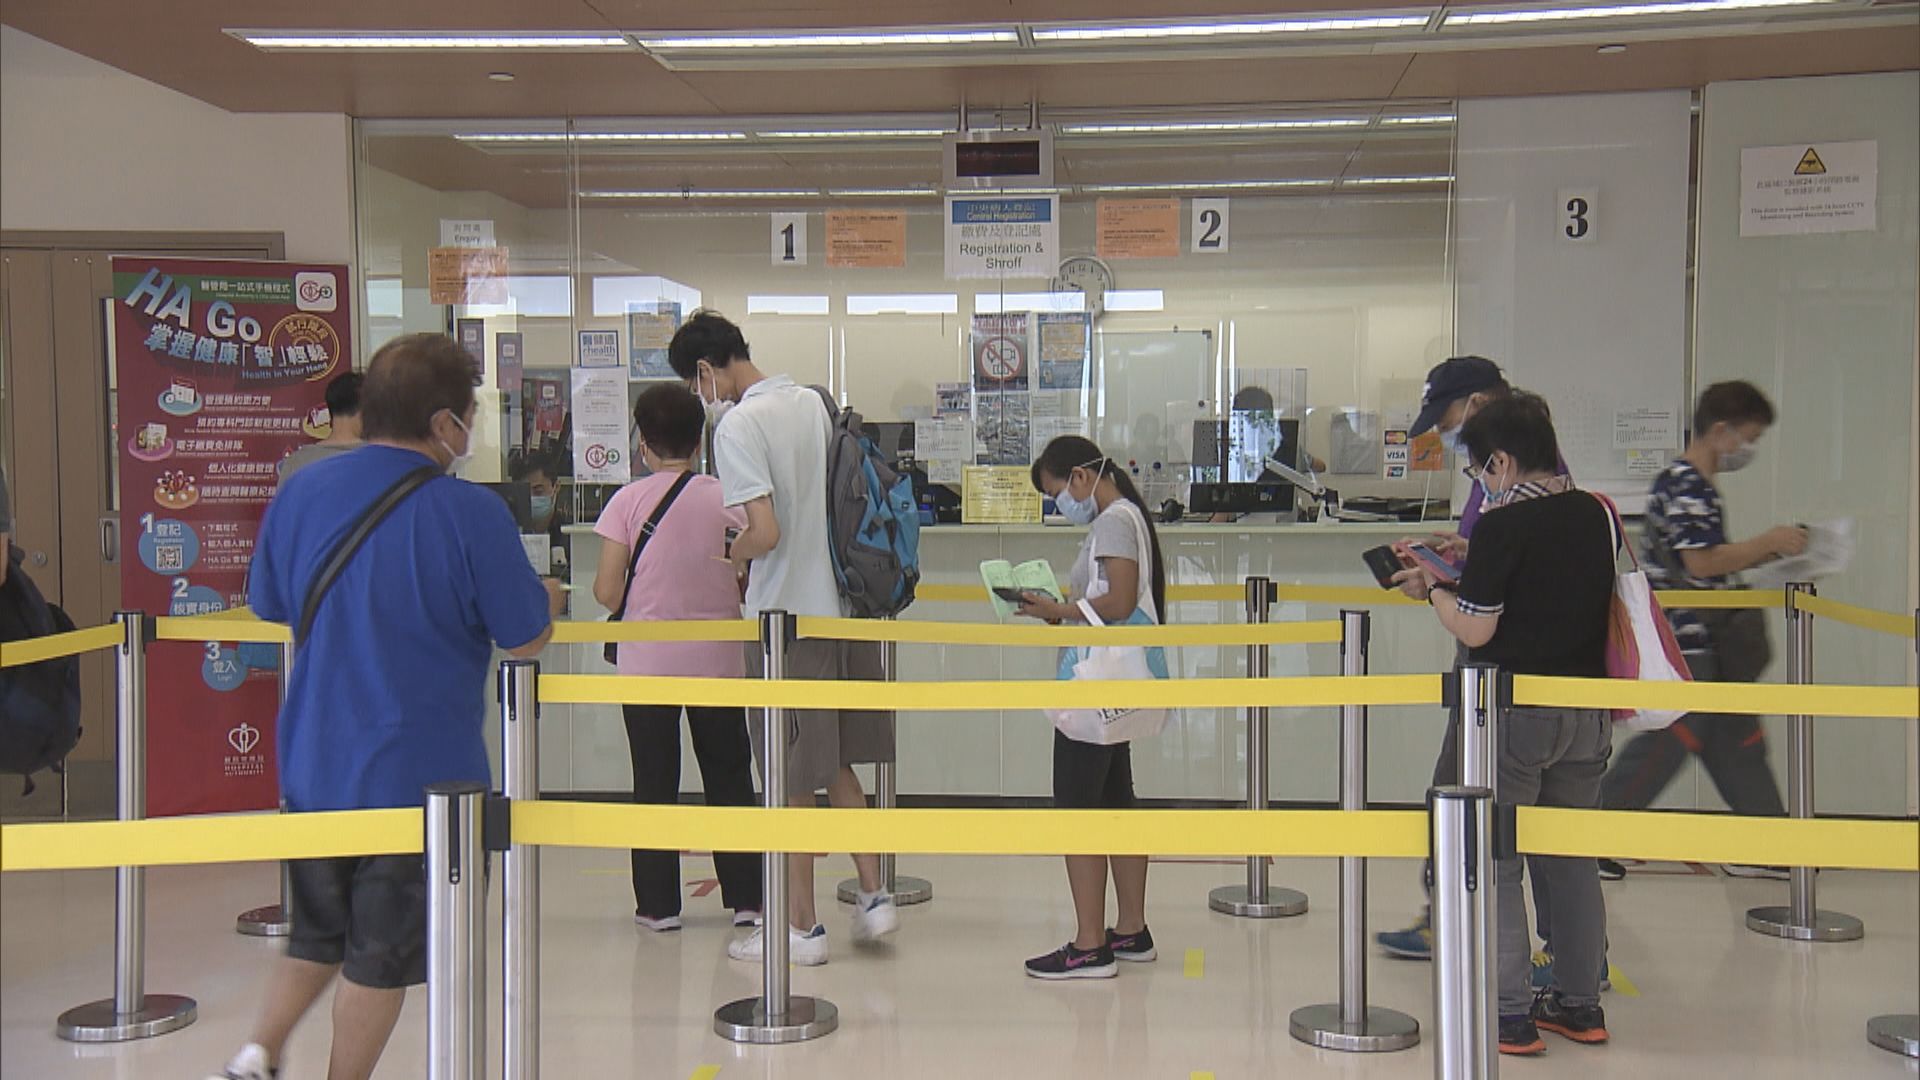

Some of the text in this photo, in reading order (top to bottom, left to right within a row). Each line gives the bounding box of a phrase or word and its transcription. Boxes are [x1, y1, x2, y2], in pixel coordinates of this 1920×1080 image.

[967, 212, 1036, 221] Central Registration
[1566, 199, 1588, 238] 3
[1199, 209, 1223, 247] 2
[780, 222, 795, 261] 1
[960, 242, 1044, 257] Registration &
[985, 256, 1022, 269] Shroff
[124, 266, 262, 342] HA Go
[242, 369, 271, 380] Health
[285, 367, 305, 378] Your
[306, 362, 328, 375] Hand
[1386, 451, 1406, 459] VISA
[142, 513, 153, 533] 1
[157, 523, 182, 536] 登記
[174, 577, 188, 598] 2
[207, 642, 220, 660] 3
[213, 660, 237, 673] 登入
